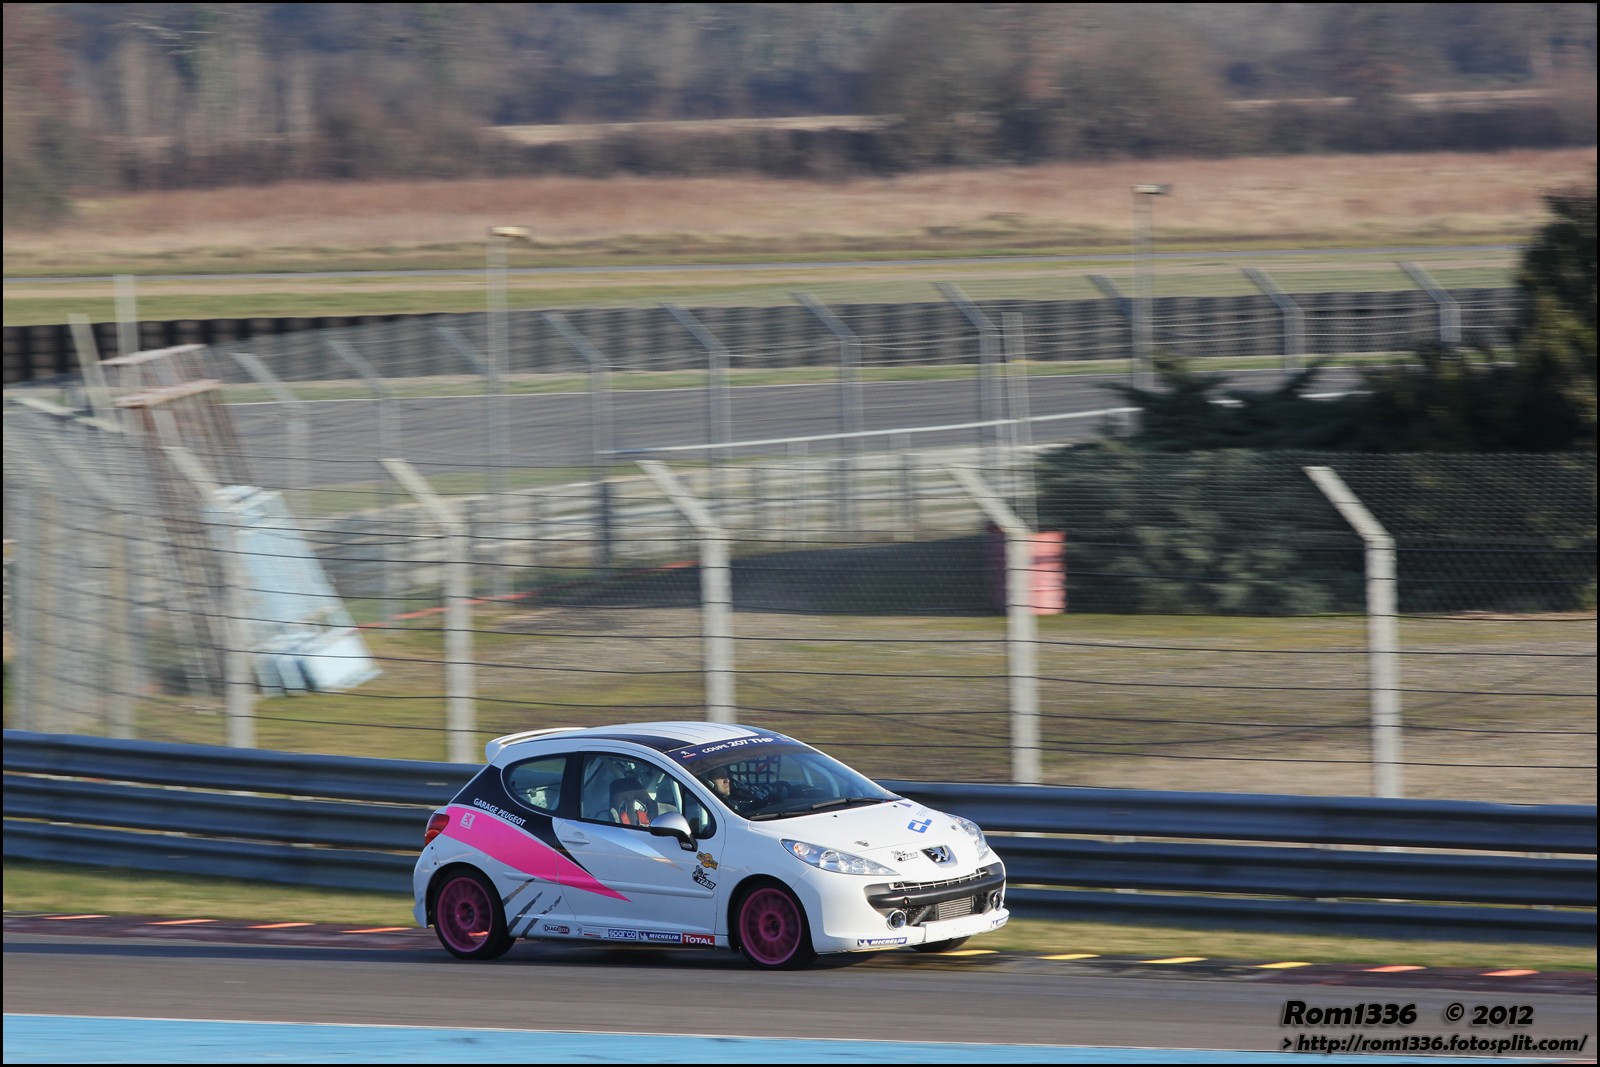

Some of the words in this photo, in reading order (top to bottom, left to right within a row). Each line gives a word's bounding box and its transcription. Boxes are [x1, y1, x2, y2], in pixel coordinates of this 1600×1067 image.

[701, 743, 729, 754] COUPE
[727, 739, 749, 747] 207
[473, 797, 499, 814] GARAGE
[497, 808, 527, 826] PEUGEOT
[608, 929, 636, 938] sparco
[648, 932, 680, 941] MICHELIN
[683, 934, 714, 945] TOTAL
[870, 937, 907, 946] MICHELIN
